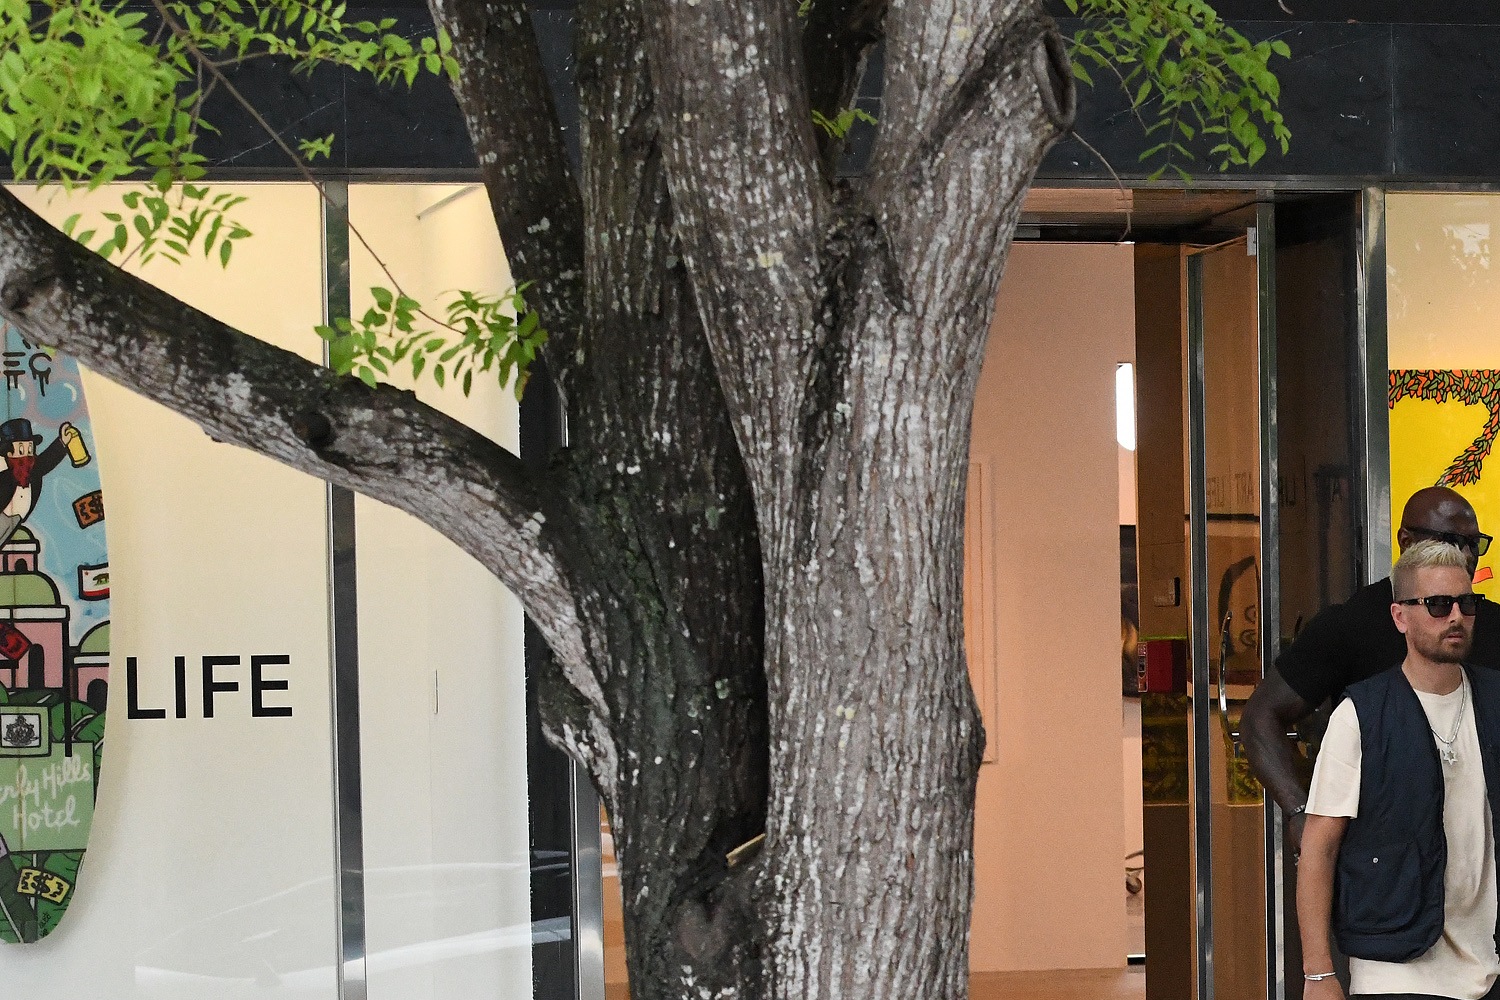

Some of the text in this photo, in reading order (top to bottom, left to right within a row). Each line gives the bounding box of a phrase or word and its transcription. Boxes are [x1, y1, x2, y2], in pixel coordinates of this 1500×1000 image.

[126, 655, 293, 719] LIFE
[42, 753, 91, 799] Hills
[13, 795, 80, 840] Hotel
